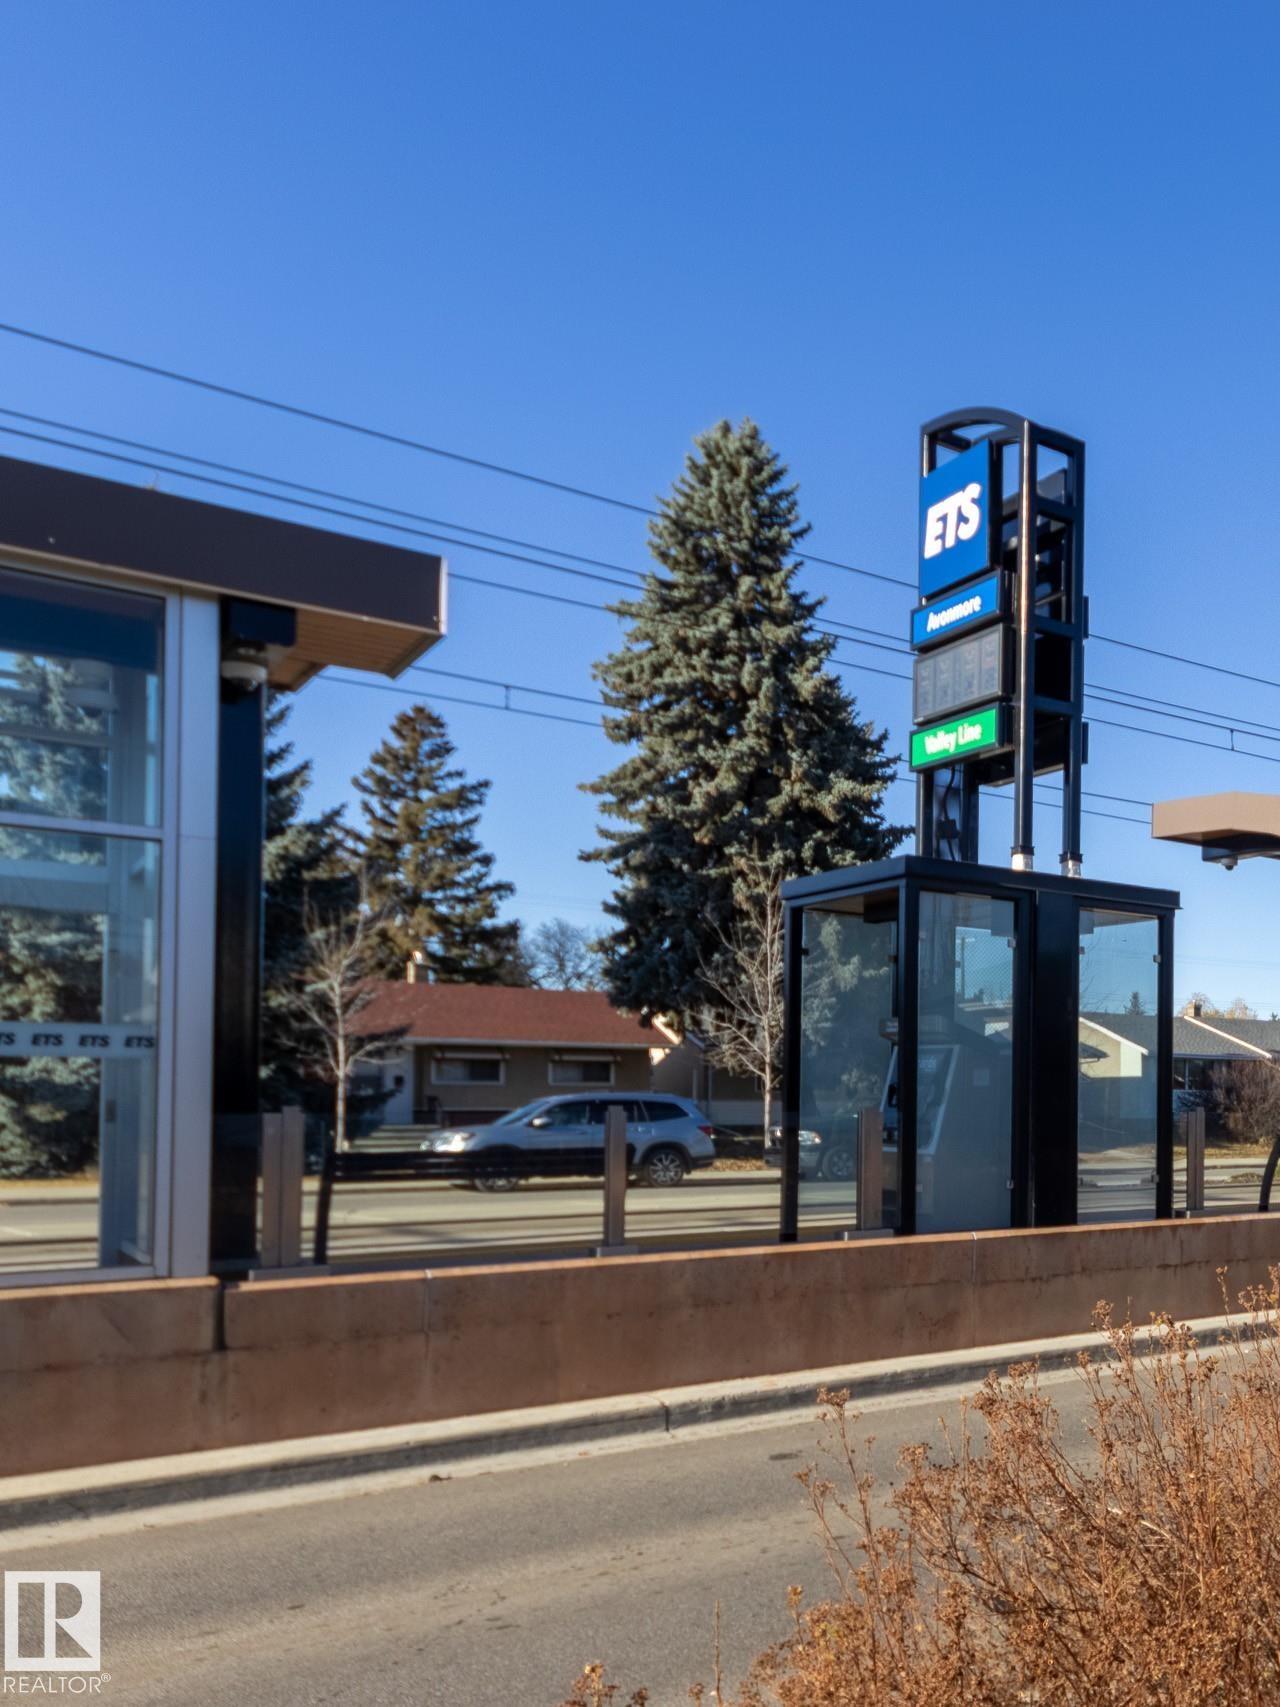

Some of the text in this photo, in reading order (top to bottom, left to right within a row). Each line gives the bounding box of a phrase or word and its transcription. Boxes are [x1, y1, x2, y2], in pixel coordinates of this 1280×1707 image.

[924, 482, 982, 559] ETS
[926, 595, 982, 632] Avonmore
[924, 722, 982, 755] Valley Line
[31, 1033, 63, 1046] ETS
[78, 1034, 110, 1047] ETS
[124, 1036, 155, 1048] ETS
